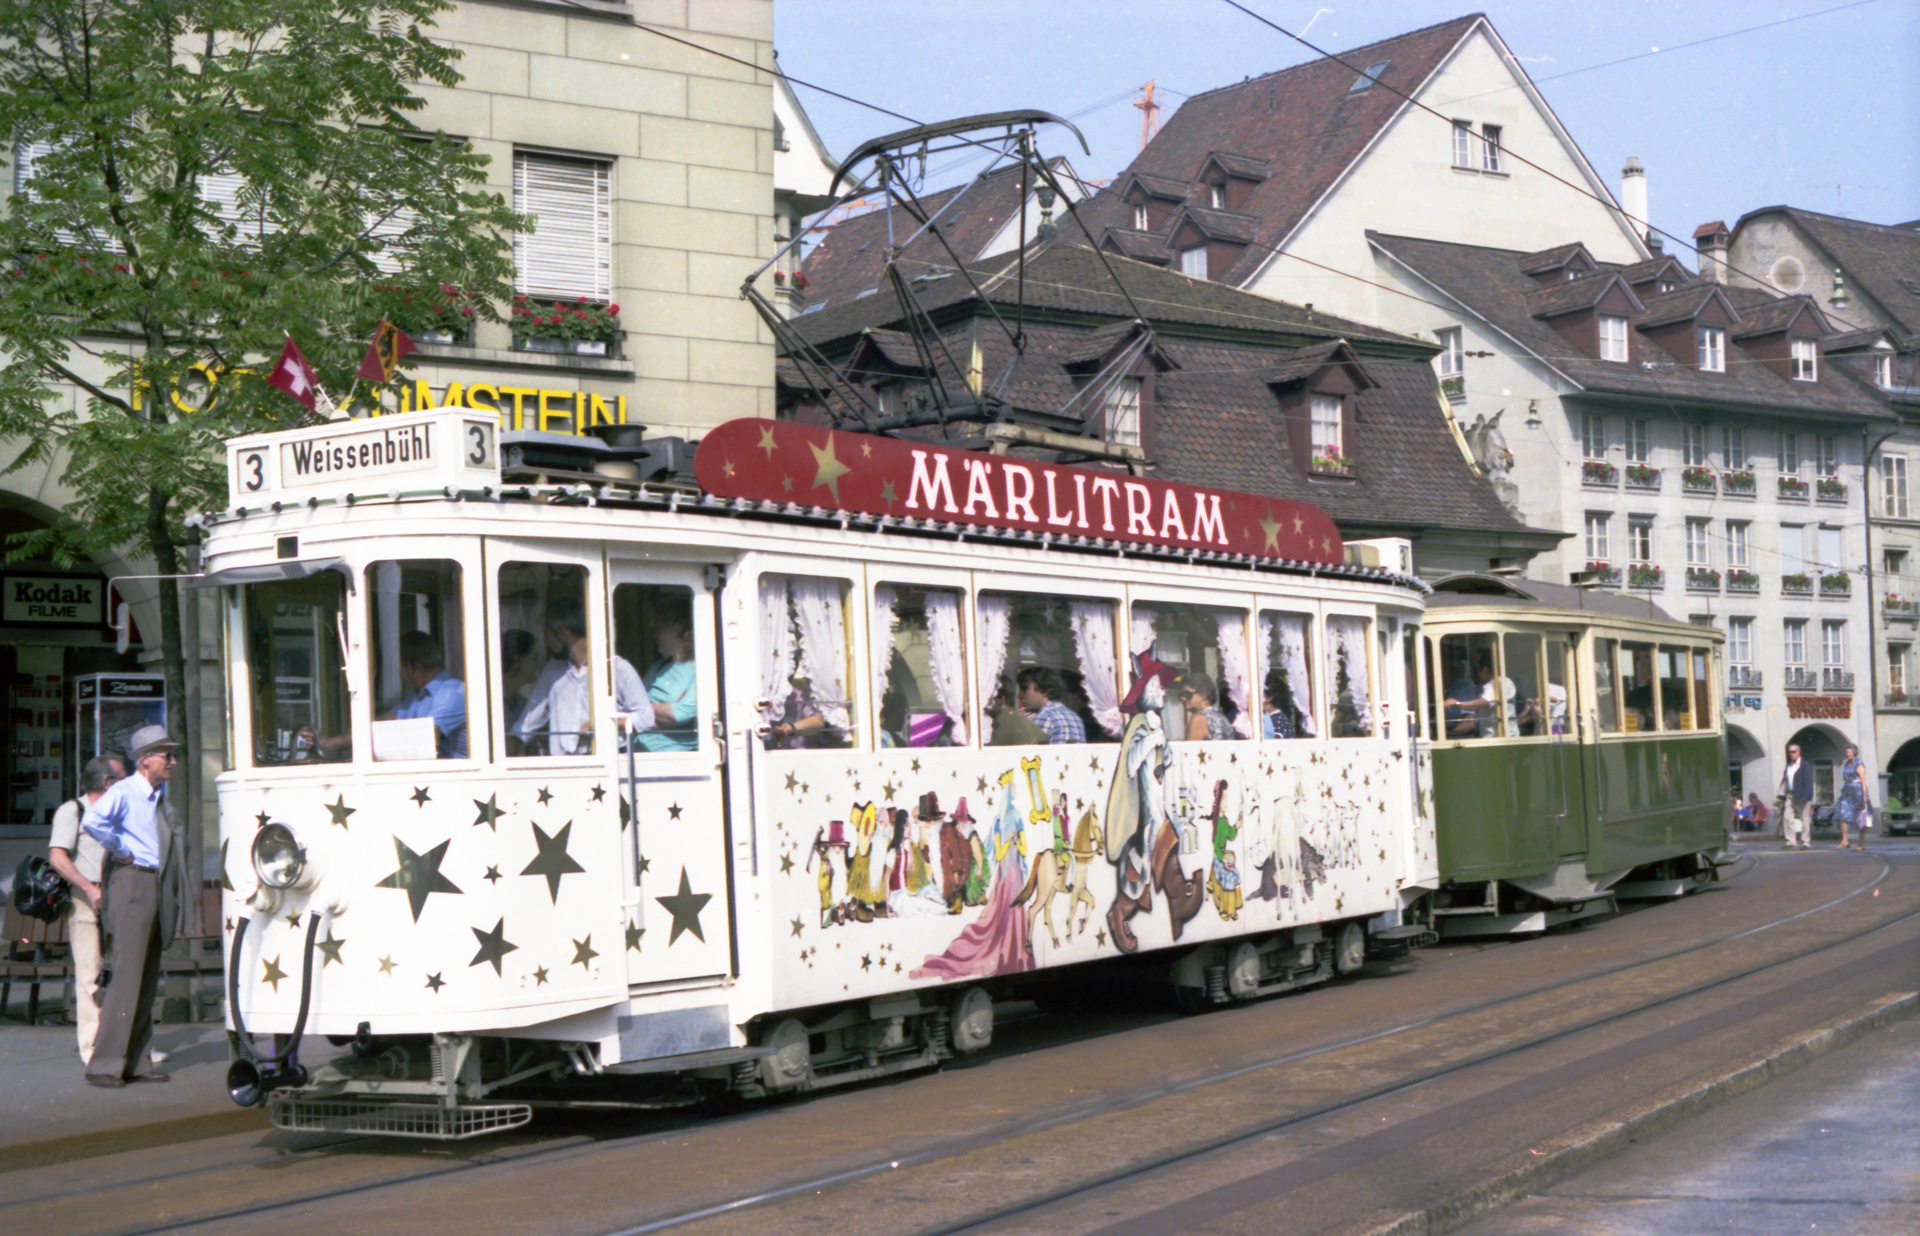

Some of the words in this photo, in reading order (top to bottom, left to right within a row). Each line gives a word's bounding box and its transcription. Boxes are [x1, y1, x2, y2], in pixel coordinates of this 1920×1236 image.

[336, 379, 626, 436] UMSTEIN
[245, 453, 263, 491] 3
[292, 424, 430, 475] Weissenbühl
[468, 425, 486, 465] 3
[905, 449, 1229, 545] MÄRLITRAM
[15, 582, 92, 603] Kodak
[28, 605, 77, 617] FILME
